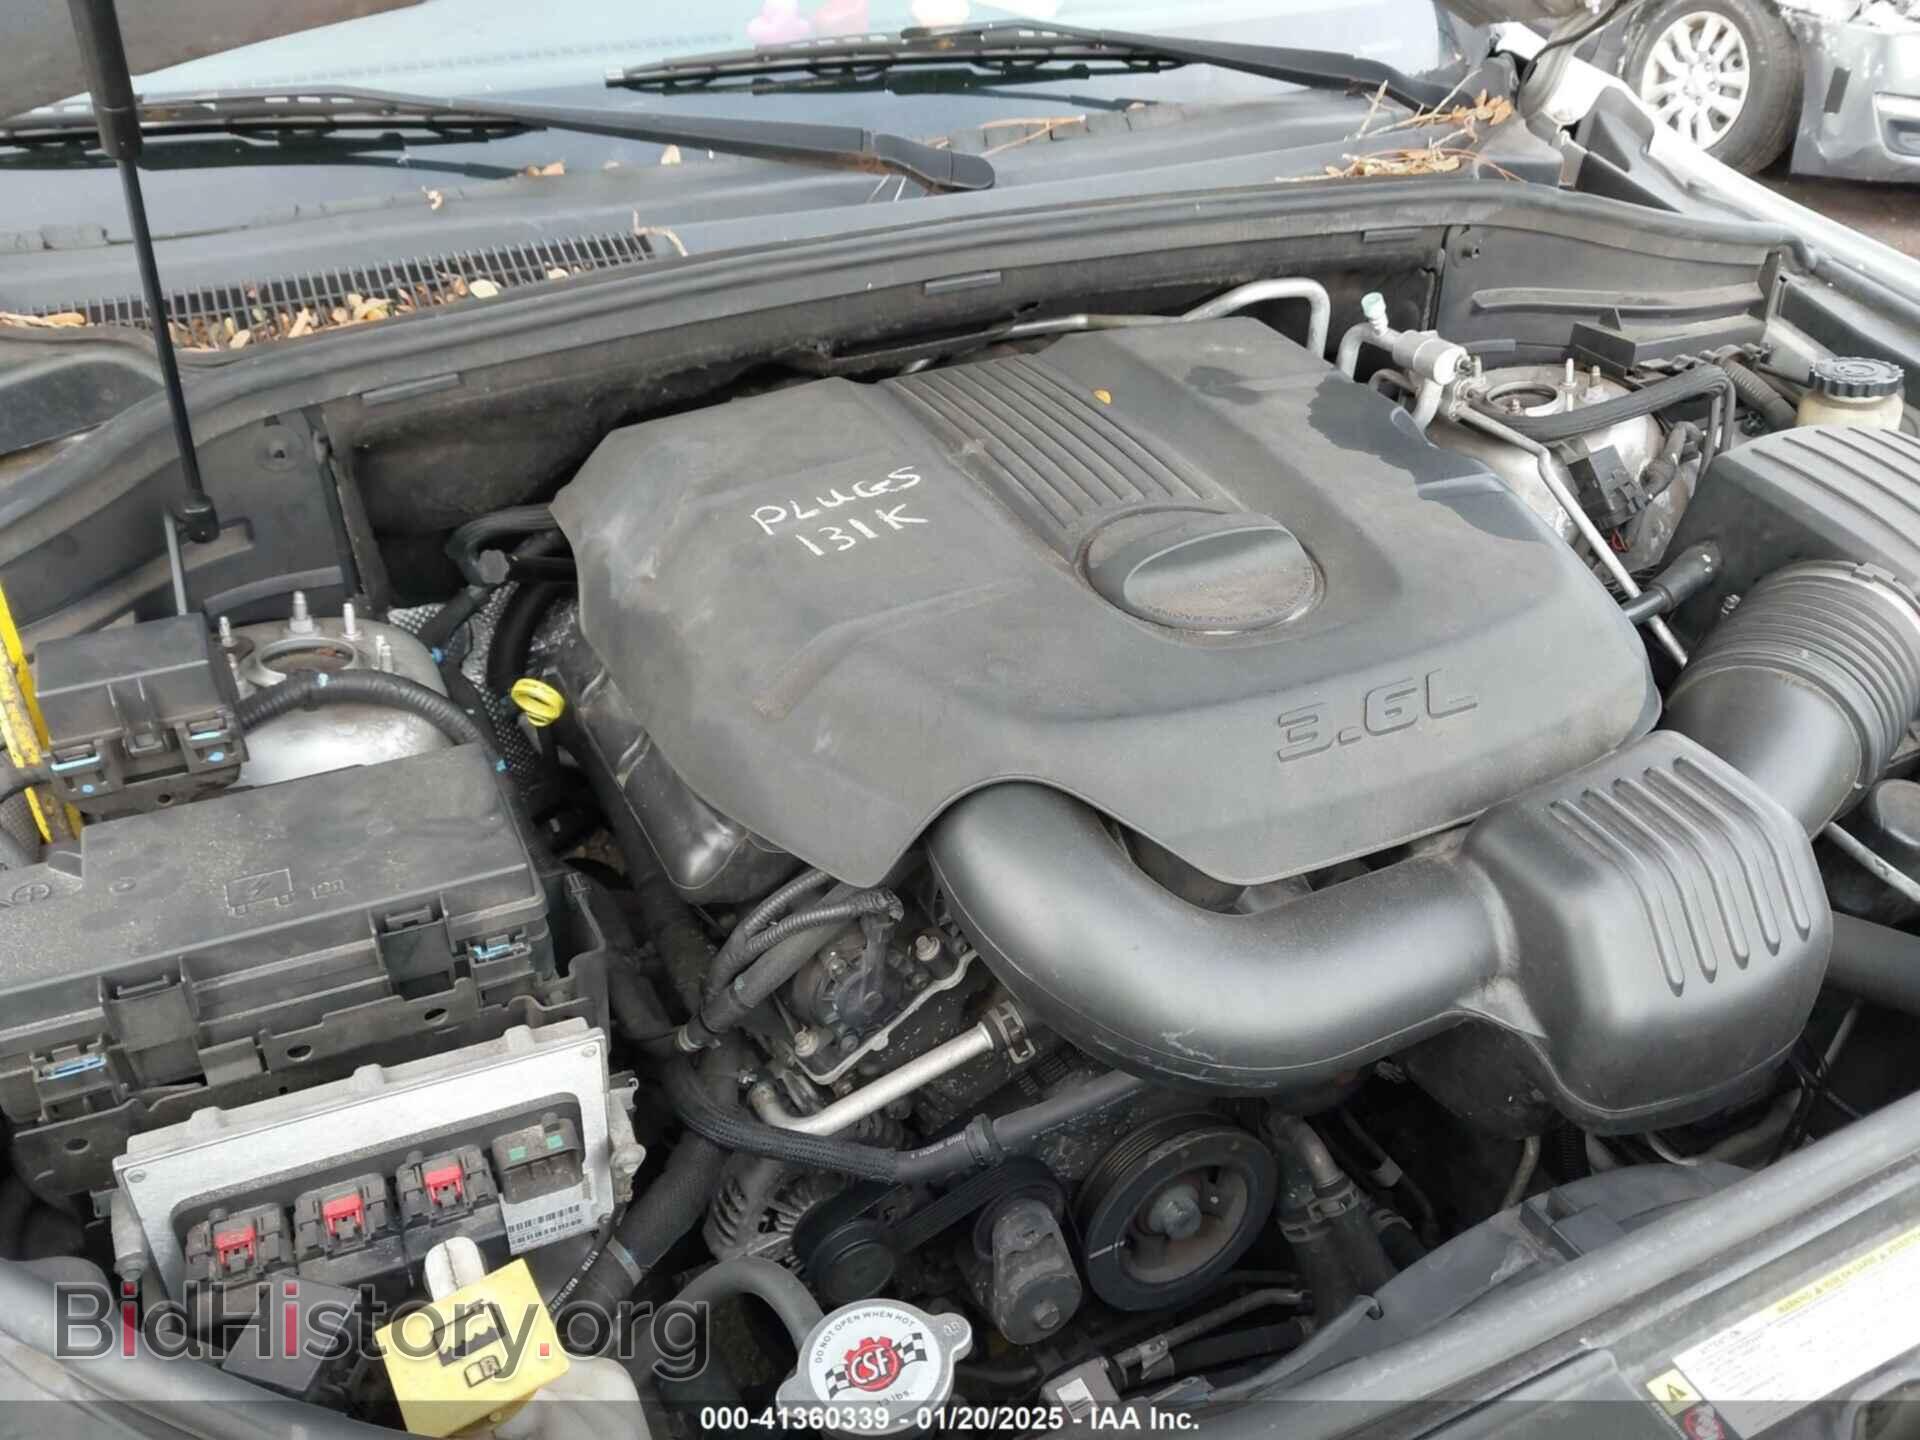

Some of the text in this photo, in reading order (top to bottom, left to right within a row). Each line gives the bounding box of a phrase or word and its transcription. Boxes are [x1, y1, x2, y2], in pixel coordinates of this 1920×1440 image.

[796, 504, 928, 556] 131K
[1276, 667, 1479, 762] 3.6L
[834, 1313, 861, 1331] OPEN
[862, 1311, 894, 1320] WHEN
[895, 1314, 915, 1327] HOT
[850, 1347, 890, 1385] CSF
